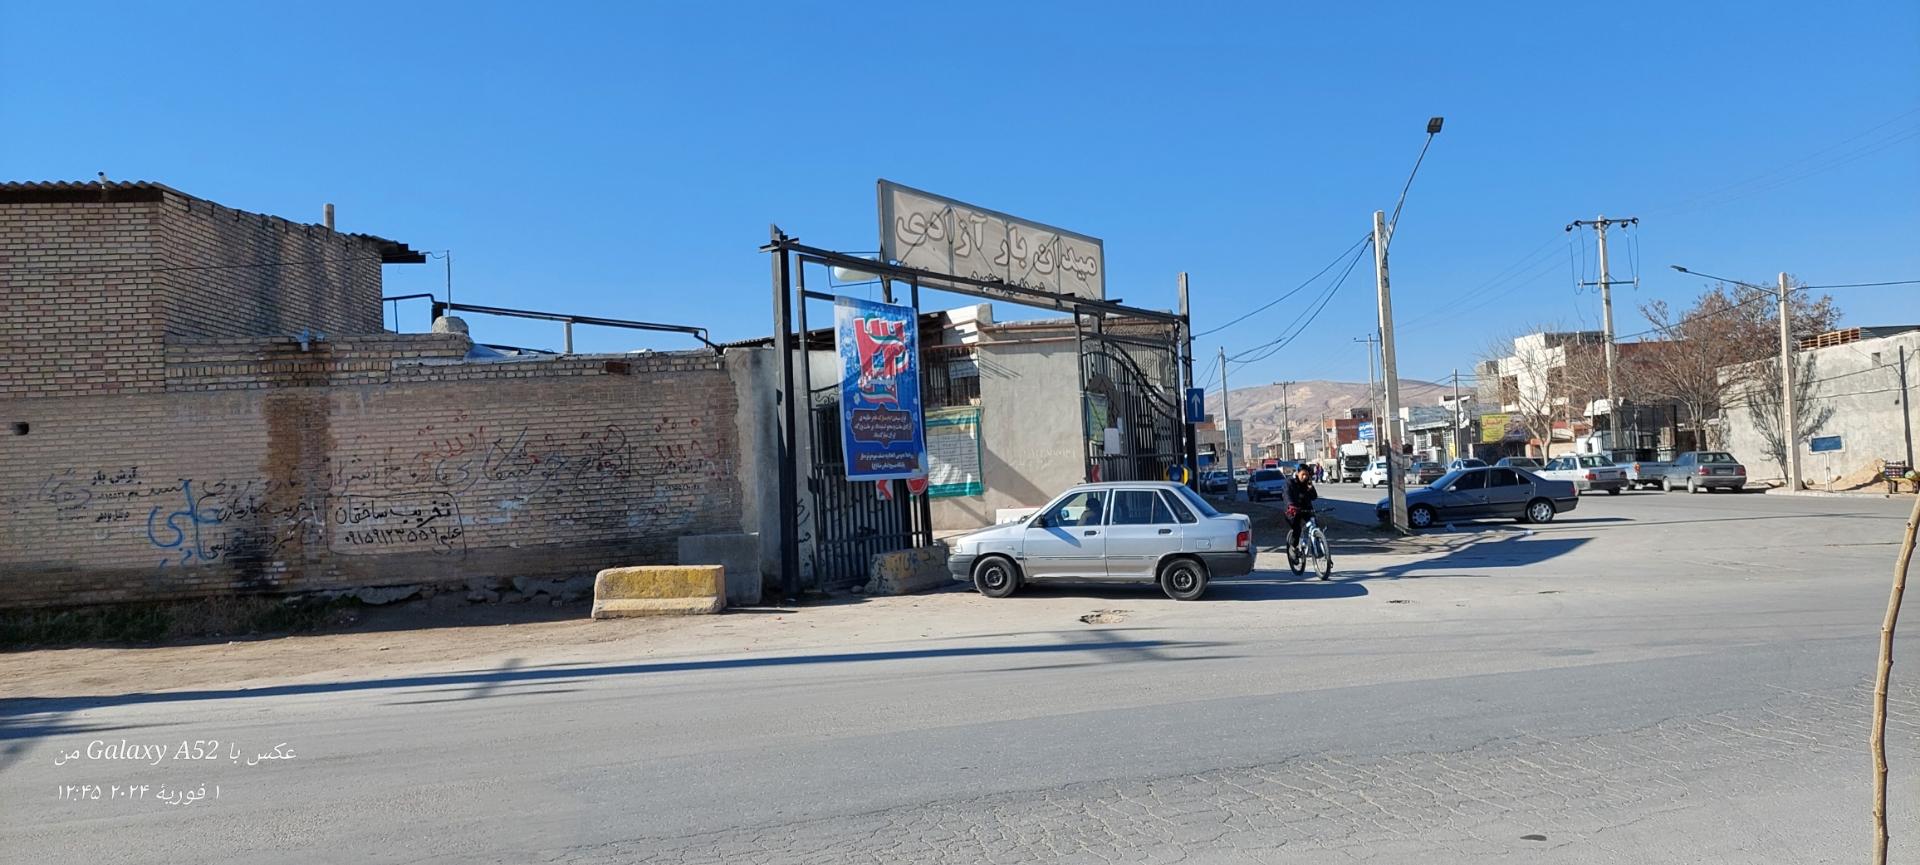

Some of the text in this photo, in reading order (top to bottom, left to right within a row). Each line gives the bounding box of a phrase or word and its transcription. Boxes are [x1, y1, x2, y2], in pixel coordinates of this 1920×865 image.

[896, 206, 1097, 280] میدان بار آزادی
[390, 501, 451, 528] تخریب
